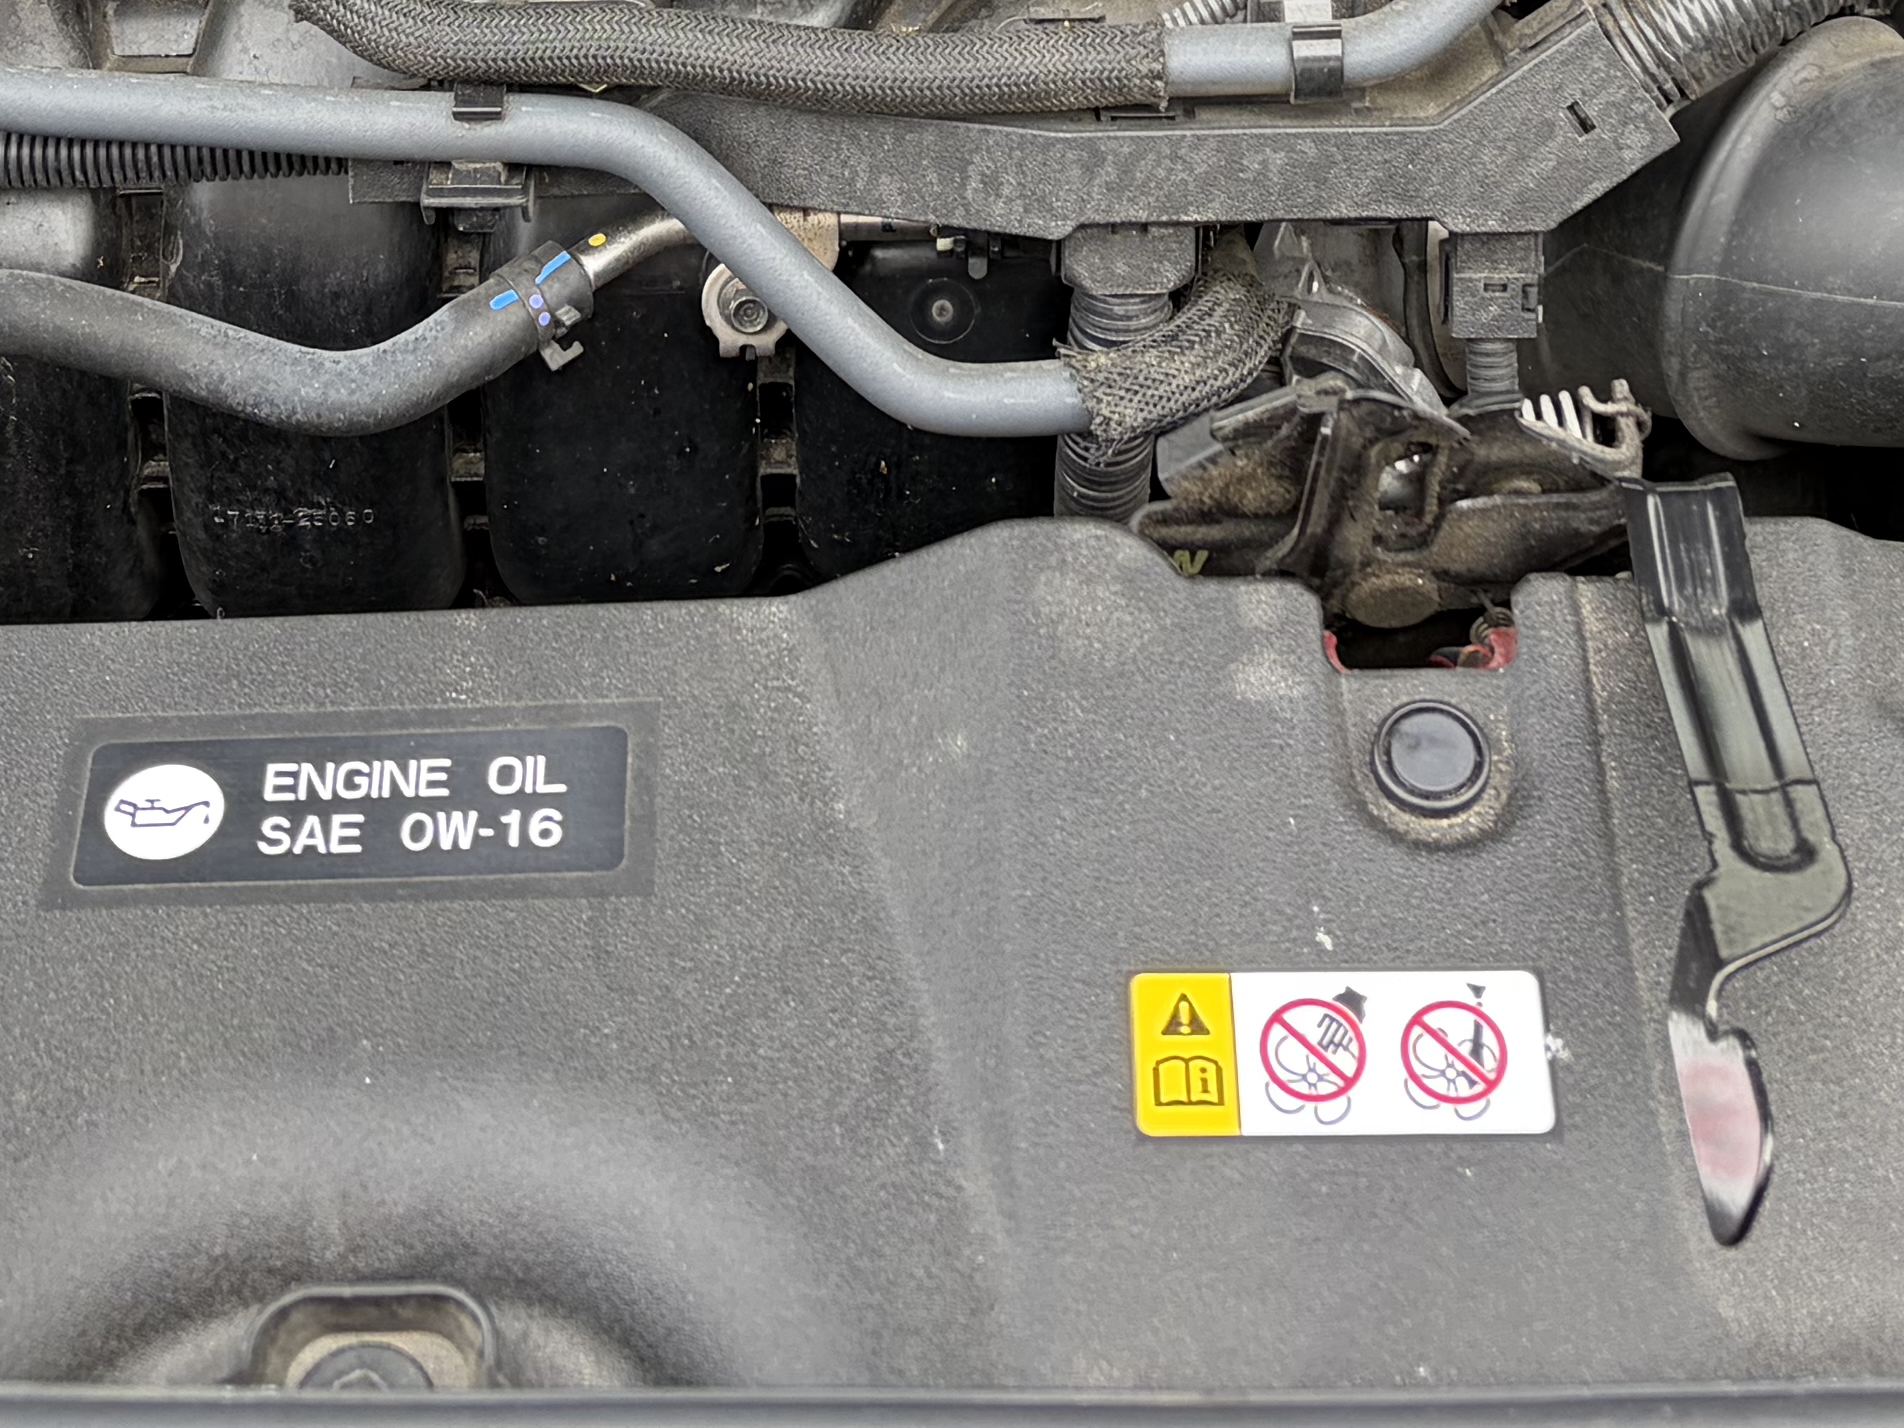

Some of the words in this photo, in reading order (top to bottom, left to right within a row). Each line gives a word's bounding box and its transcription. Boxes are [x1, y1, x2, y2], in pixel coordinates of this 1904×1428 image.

[264, 757, 451, 803] ENGINE
[486, 754, 567, 796] OIL
[257, 813, 364, 856] SAE
[400, 807, 564, 852] 0W-16
